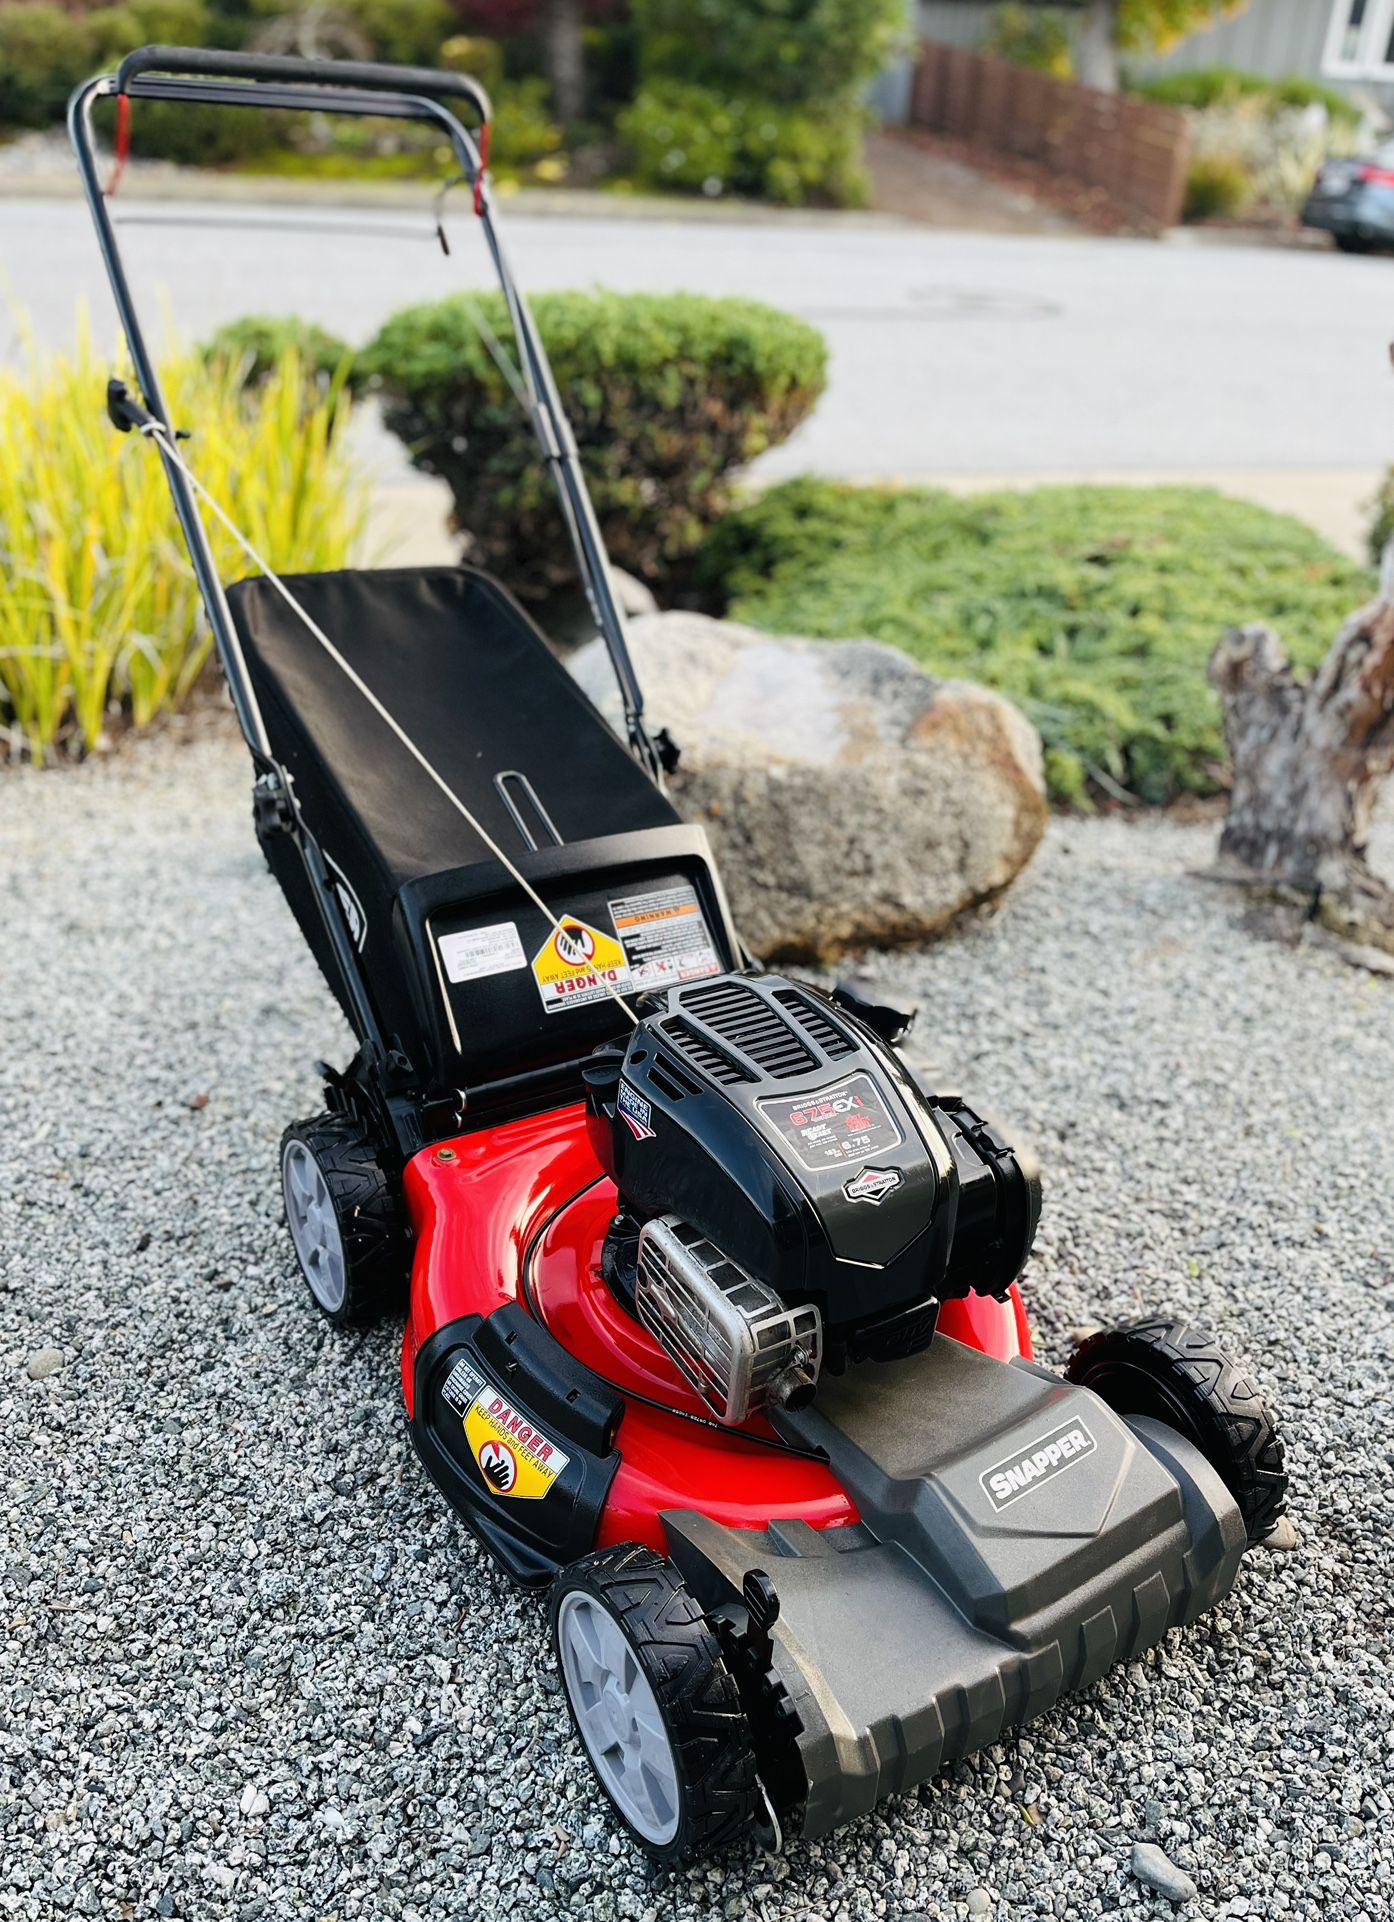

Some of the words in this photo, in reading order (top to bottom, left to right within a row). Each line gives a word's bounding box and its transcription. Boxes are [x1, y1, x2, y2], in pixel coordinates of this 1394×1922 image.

[634, 910, 672, 922] WARNING
[561, 970, 575, 979] FEET
[586, 962, 606, 973] HANS
[542, 973, 560, 983] AWAY
[620, 1082, 649, 1112] ENGINE
[620, 1089, 638, 1110] MADE
[639, 1107, 648, 1118] IN
[632, 1106, 648, 1123] USA
[487, 1397, 554, 1462] DANGER
[475, 1405, 491, 1421] KEEP
[488, 1418, 510, 1440] HANDS
[506, 1437, 519, 1450] and
[517, 1445, 535, 1463] FEET
[532, 1460, 554, 1479] AWAY
